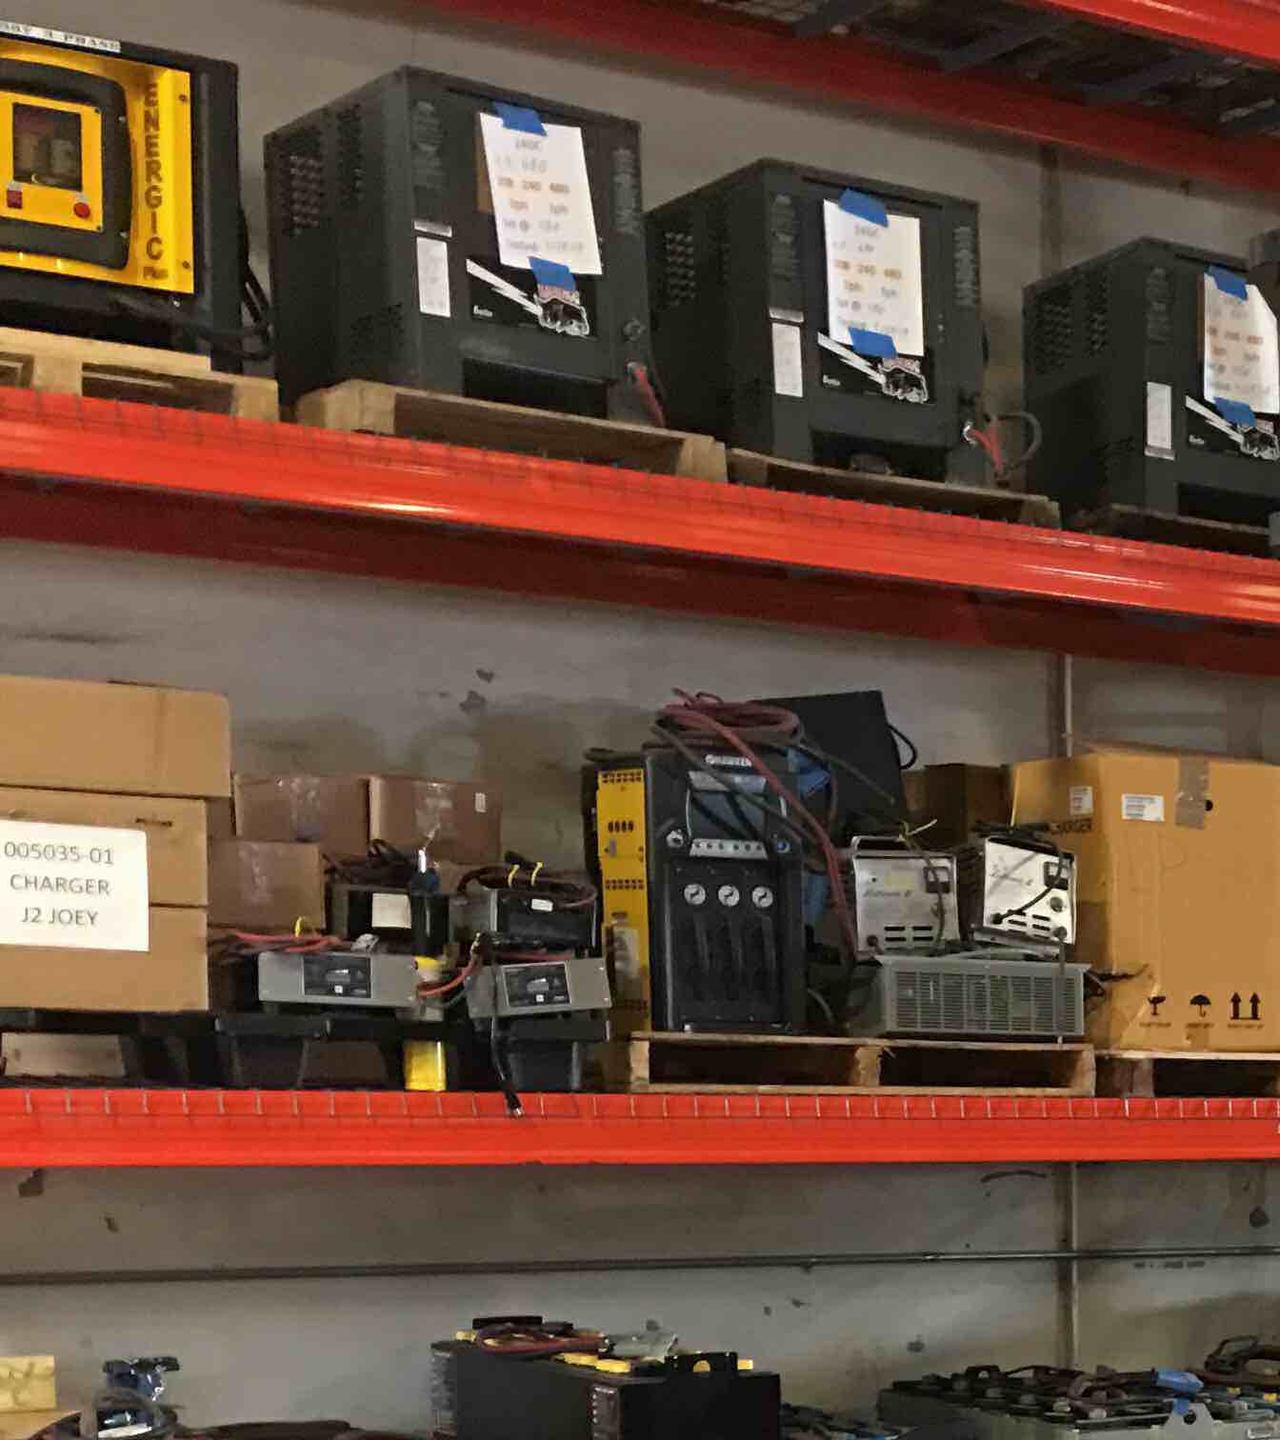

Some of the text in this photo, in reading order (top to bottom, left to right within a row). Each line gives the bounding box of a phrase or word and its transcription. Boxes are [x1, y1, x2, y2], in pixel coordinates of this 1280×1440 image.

[142, 82, 163, 261] ENERGIC
[4, 841, 114, 865] 005035-01
[10, 874, 110, 896] CHARGER
[21, 907, 98, 926] J2 JOEY
